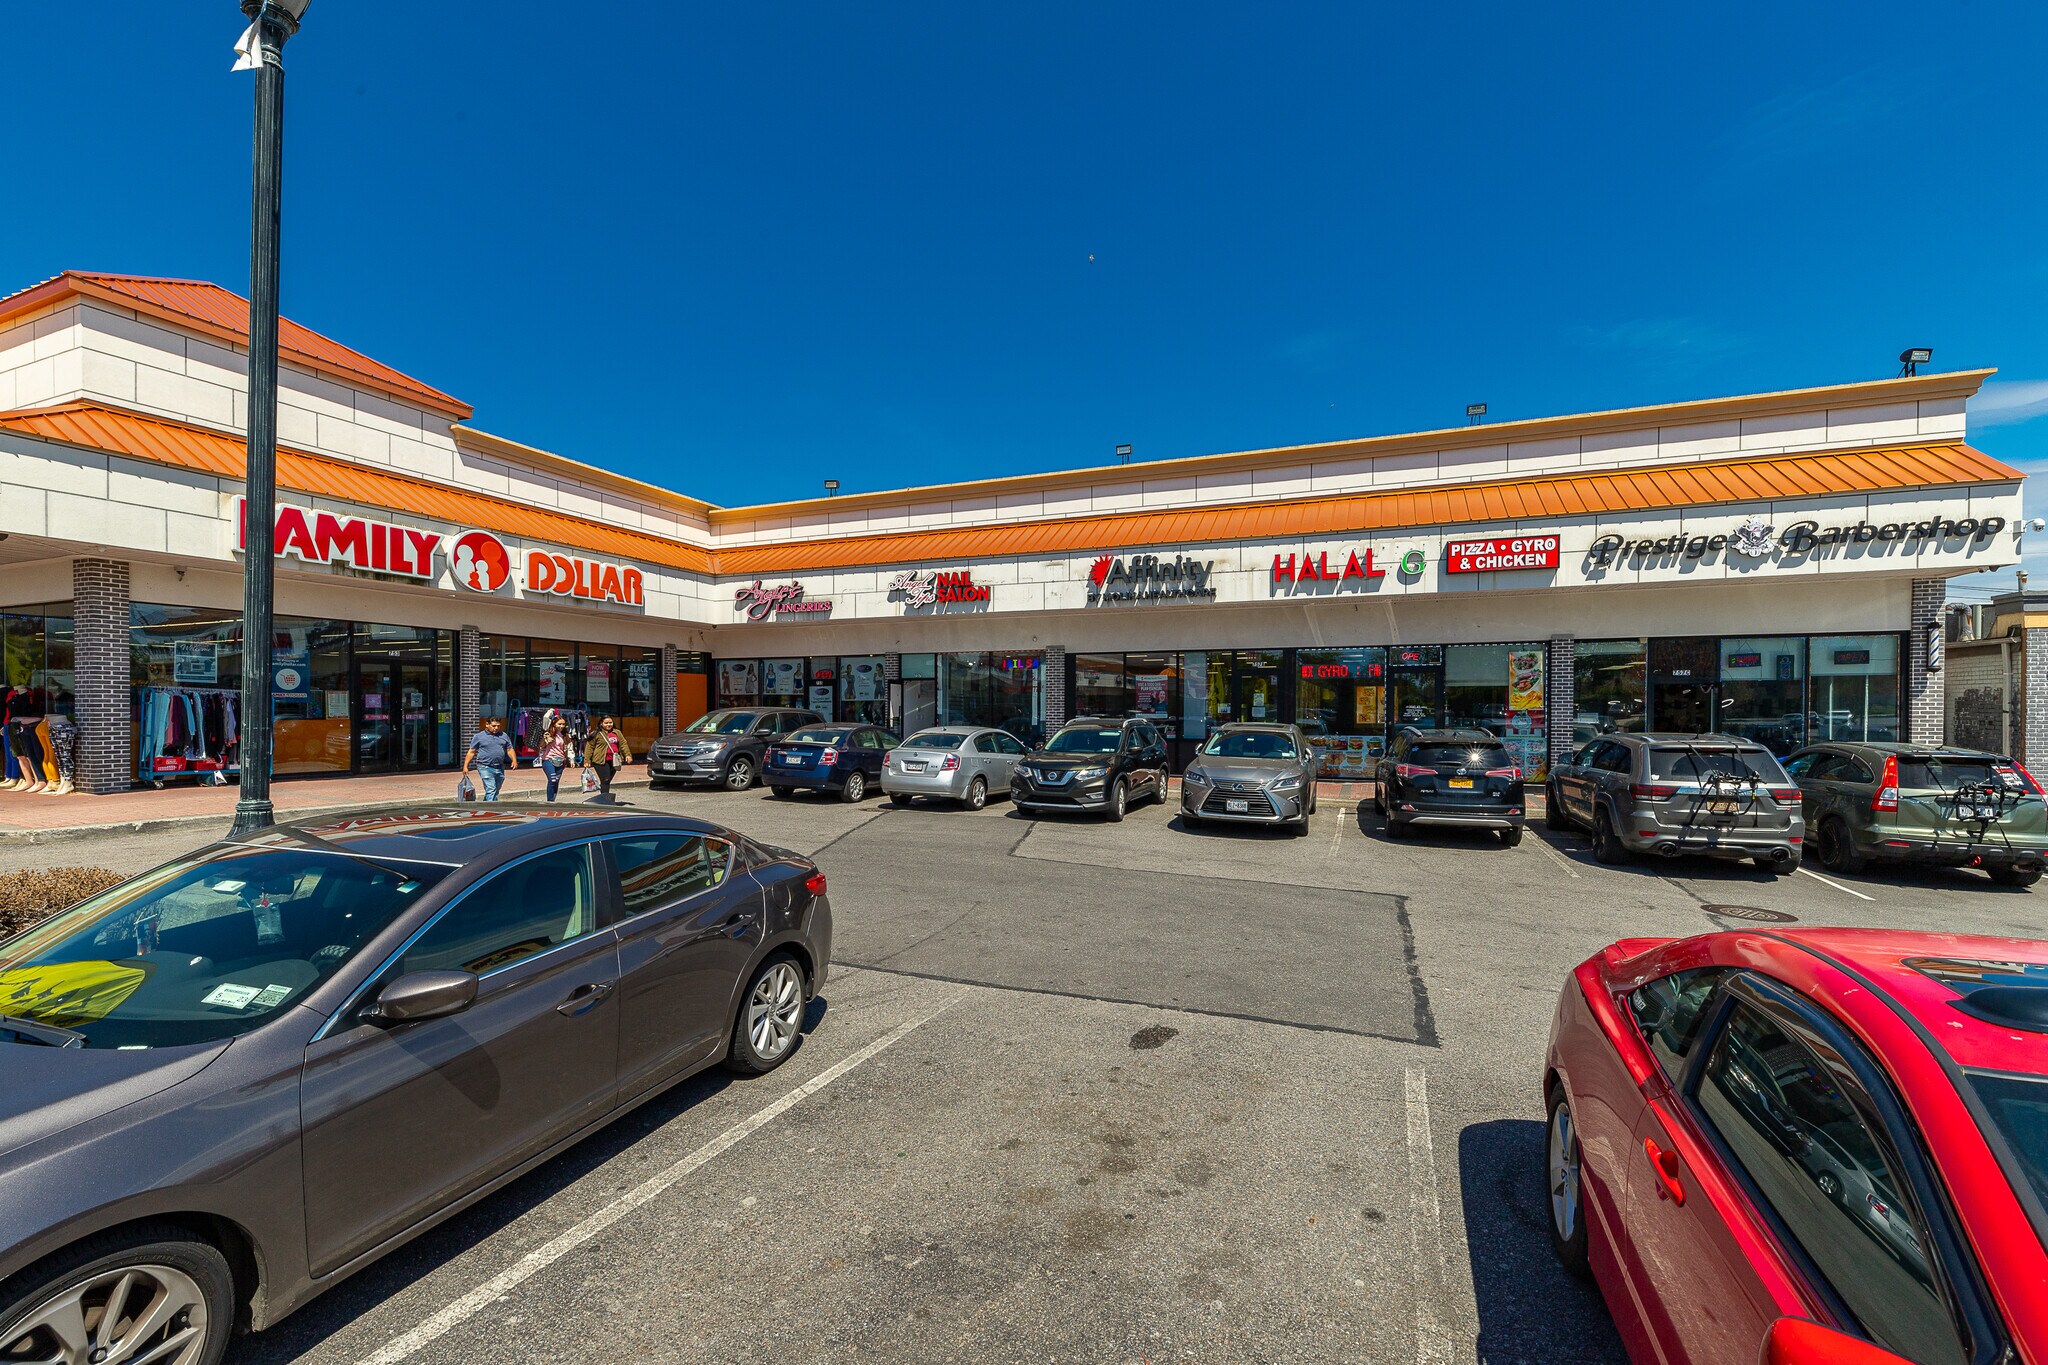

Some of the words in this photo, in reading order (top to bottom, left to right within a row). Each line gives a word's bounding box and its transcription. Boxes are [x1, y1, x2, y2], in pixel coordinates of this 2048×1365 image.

[240, 499, 441, 577] AMILY
[1451, 542, 1495, 557] PIZZA
[1511, 538, 1557, 552] GYRO
[1589, 532, 1729, 567] Prestige
[1779, 516, 2006, 555] Barbershop
[1107, 555, 1214, 587] Affinity
[1274, 548, 1386, 582] HALAL
[1459, 558, 1471, 570] &
[1475, 554, 1547, 569] CHICKEN
[528, 551, 643, 606] DOLLAR
[888, 570, 935, 594] Angel
[937, 571, 974, 587] NAIL
[905, 586, 937, 609] Tips
[937, 585, 991, 602] SALON
[629, 665, 648, 673] BLACK
[1317, 664, 1349, 677] GYRO
